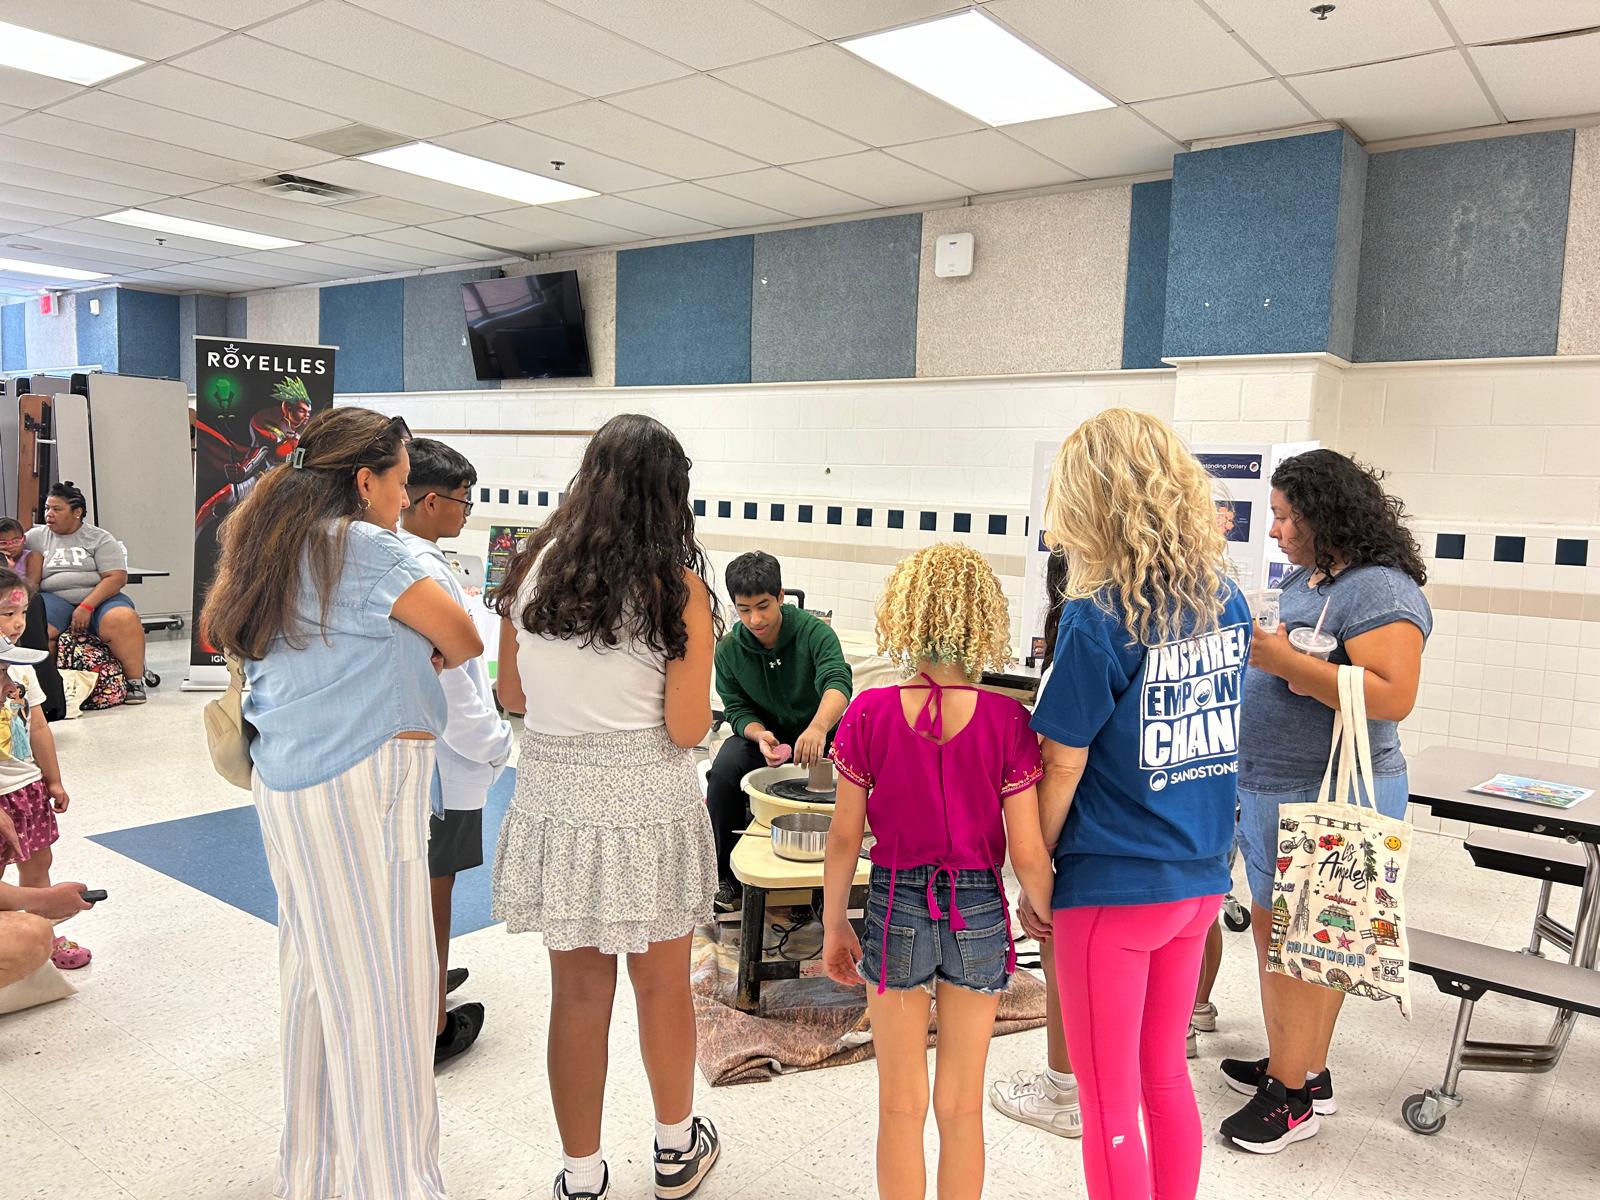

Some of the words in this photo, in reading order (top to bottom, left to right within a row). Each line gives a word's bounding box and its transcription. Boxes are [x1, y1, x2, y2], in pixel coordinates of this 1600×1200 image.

[207, 352, 326, 375] ROYELLES
[1227, 463, 1248, 471] Pottery
[44, 547, 87, 568] AP
[1170, 761, 1238, 785] SANDSTONE
[1286, 940, 1366, 968] HOLLYWOOD
[1384, 965, 1397, 976] 66
[659, 1153, 676, 1161] NIKE
